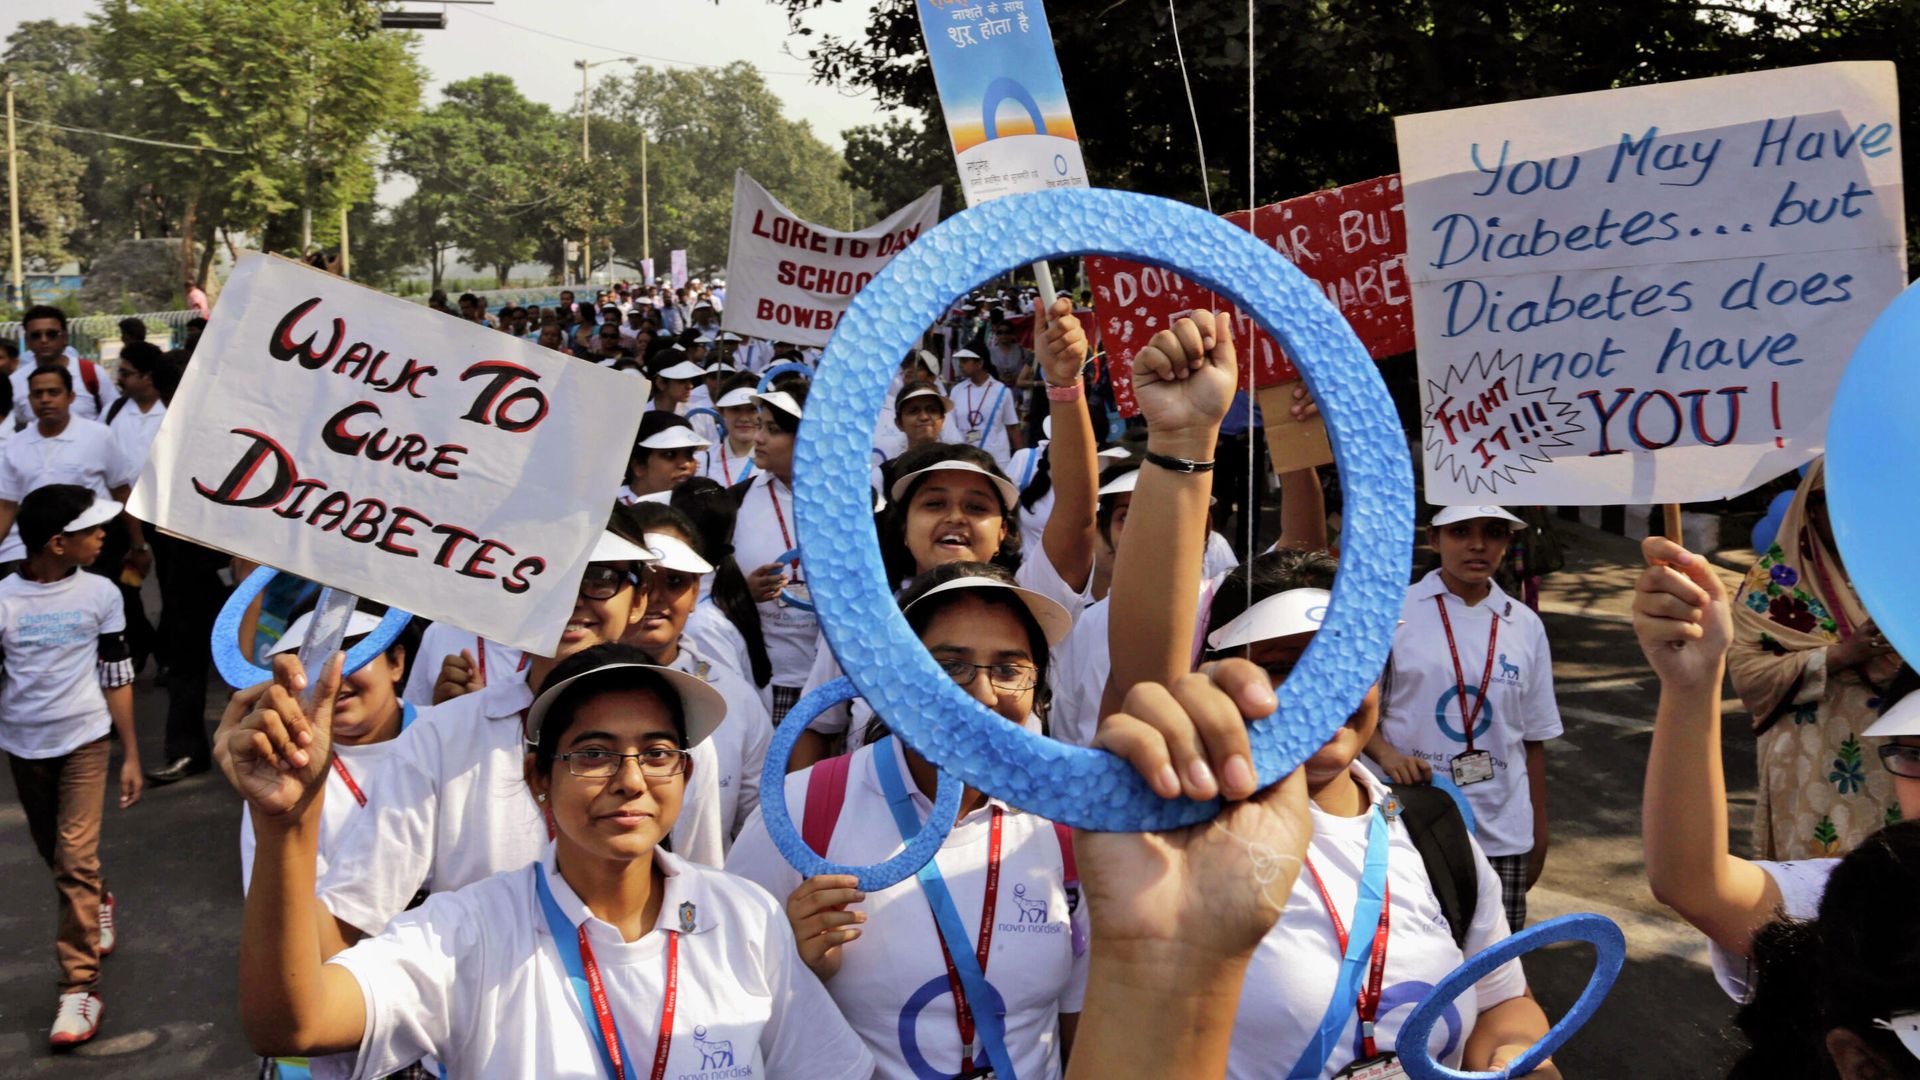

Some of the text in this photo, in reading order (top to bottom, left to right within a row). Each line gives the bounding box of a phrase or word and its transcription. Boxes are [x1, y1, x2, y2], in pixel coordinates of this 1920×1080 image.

[947, 12, 1029, 48] शुरू होता है
[987, 2, 999, 14] के
[1471, 115, 1893, 196] You May Have
[1769, 180, 1874, 227] but
[752, 209, 922, 259] LORETO DAY
[777, 260, 878, 296] SCHOO
[1114, 267, 1184, 307] DON
[1441, 262, 1856, 338] Diabetes does
[268, 297, 551, 434] WALK TO
[1528, 327, 1804, 384] not have
[1435, 378, 1510, 445] FIGHT
[321, 400, 470, 481] CURE
[190, 427, 548, 595] DIABETES
[1412, 748, 1443, 762] World
[1490, 756, 1509, 770] Day
[998, 923, 1026, 933] novo
[711, 1064, 753, 1080] nordisk
